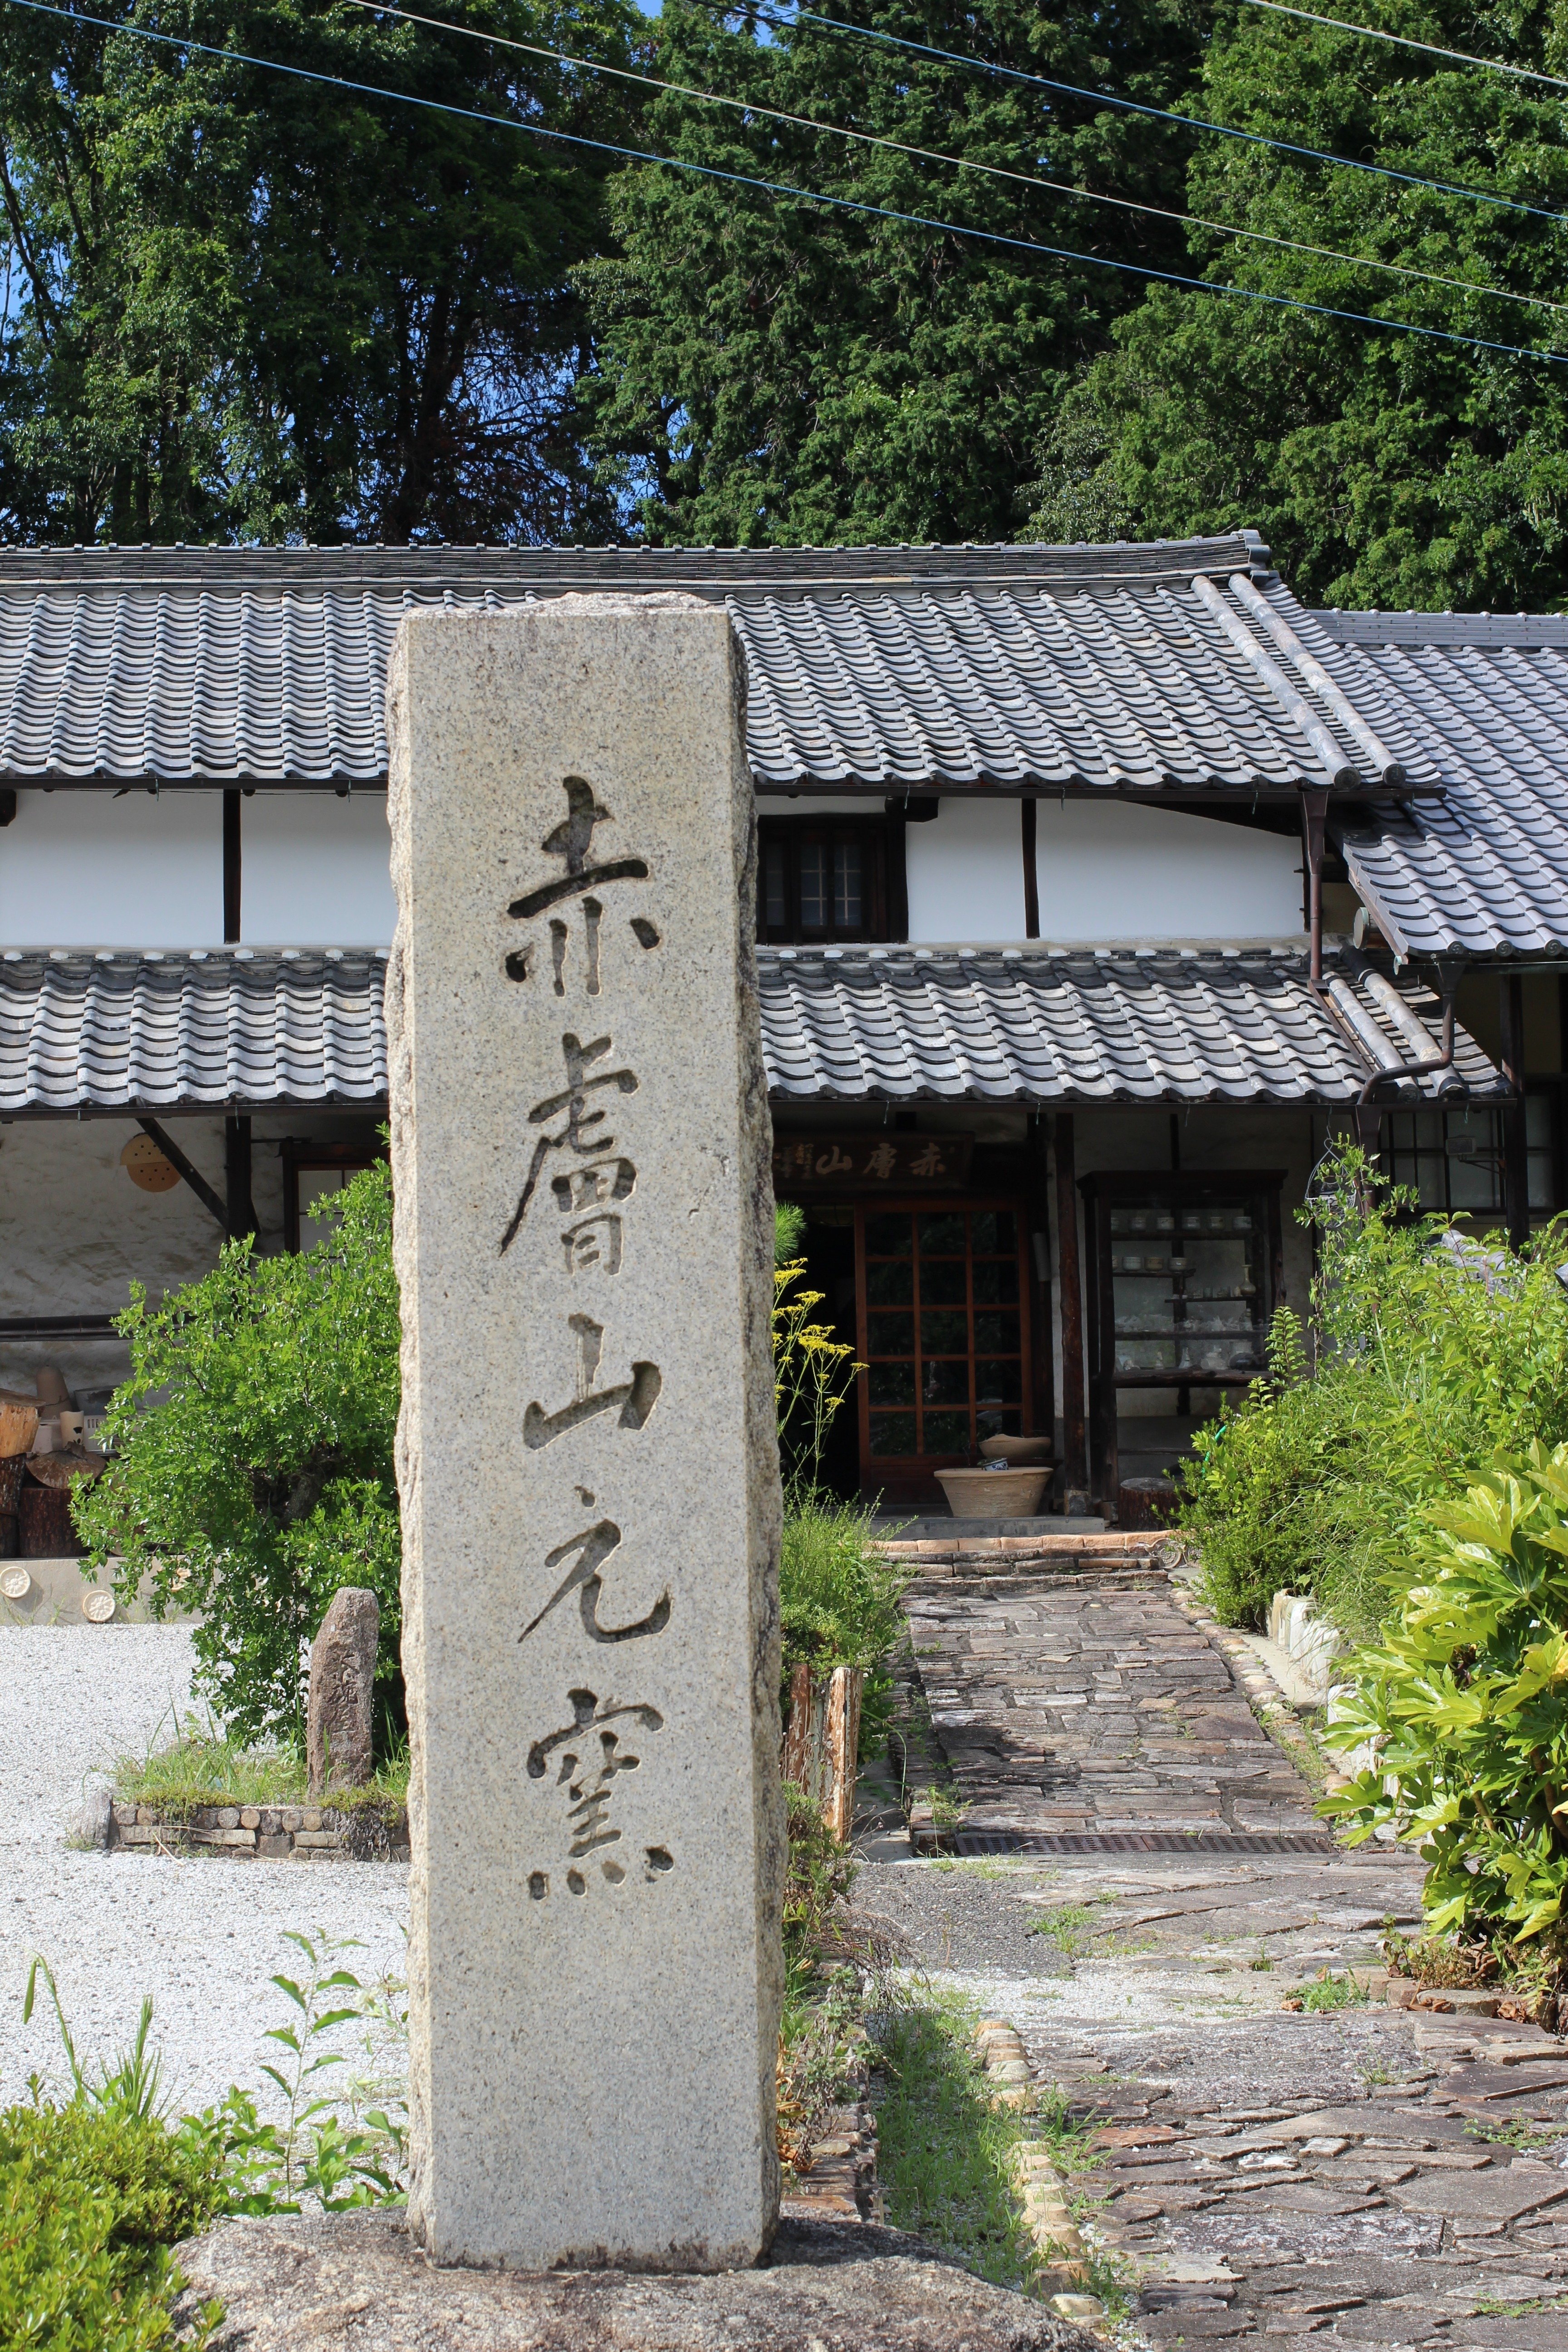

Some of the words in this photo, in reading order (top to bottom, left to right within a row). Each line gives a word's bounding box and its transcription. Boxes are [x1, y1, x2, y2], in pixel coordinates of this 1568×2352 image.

[500, 775, 674, 1900] 赤膚山元窯
